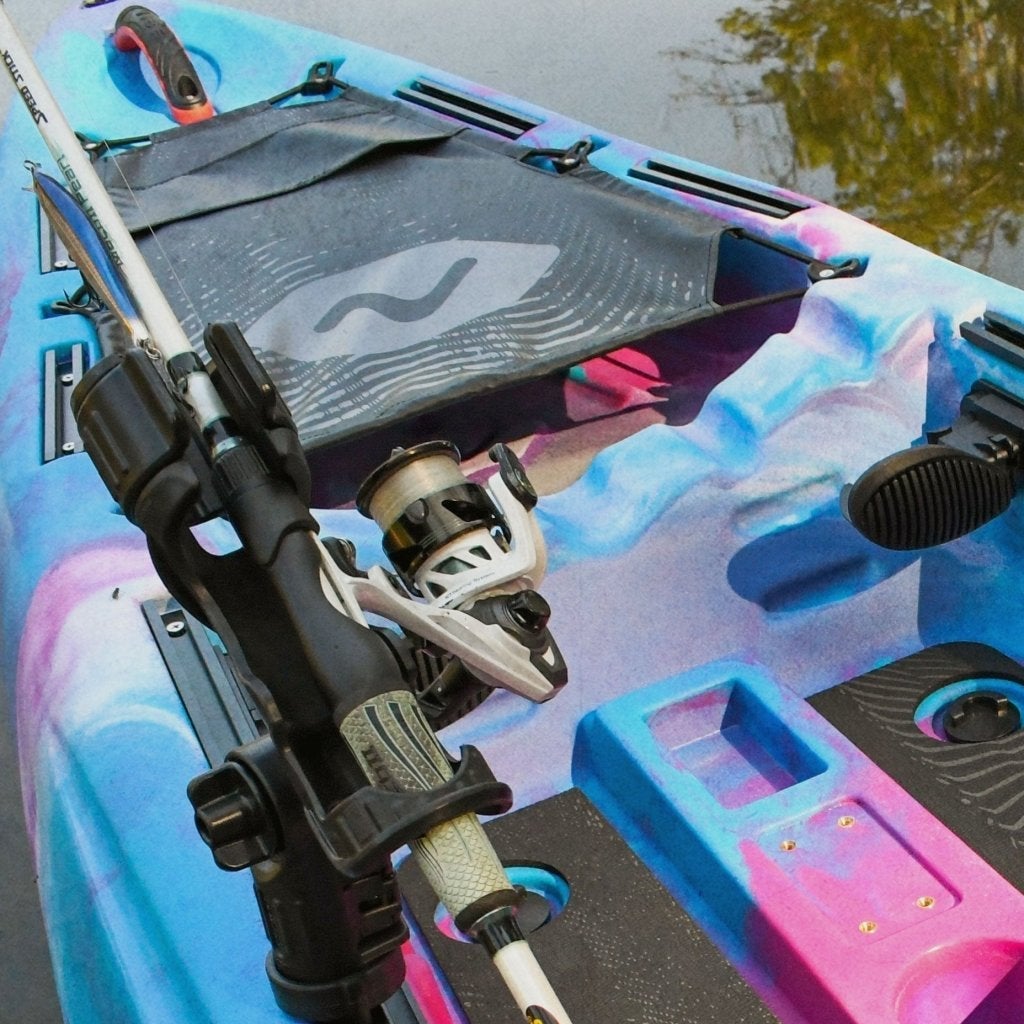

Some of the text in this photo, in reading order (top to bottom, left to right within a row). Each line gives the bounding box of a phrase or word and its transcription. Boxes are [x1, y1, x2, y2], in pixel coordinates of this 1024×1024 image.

[1, 50, 48, 125] SPEED STICK
[57, 153, 89, 206] Pearl
